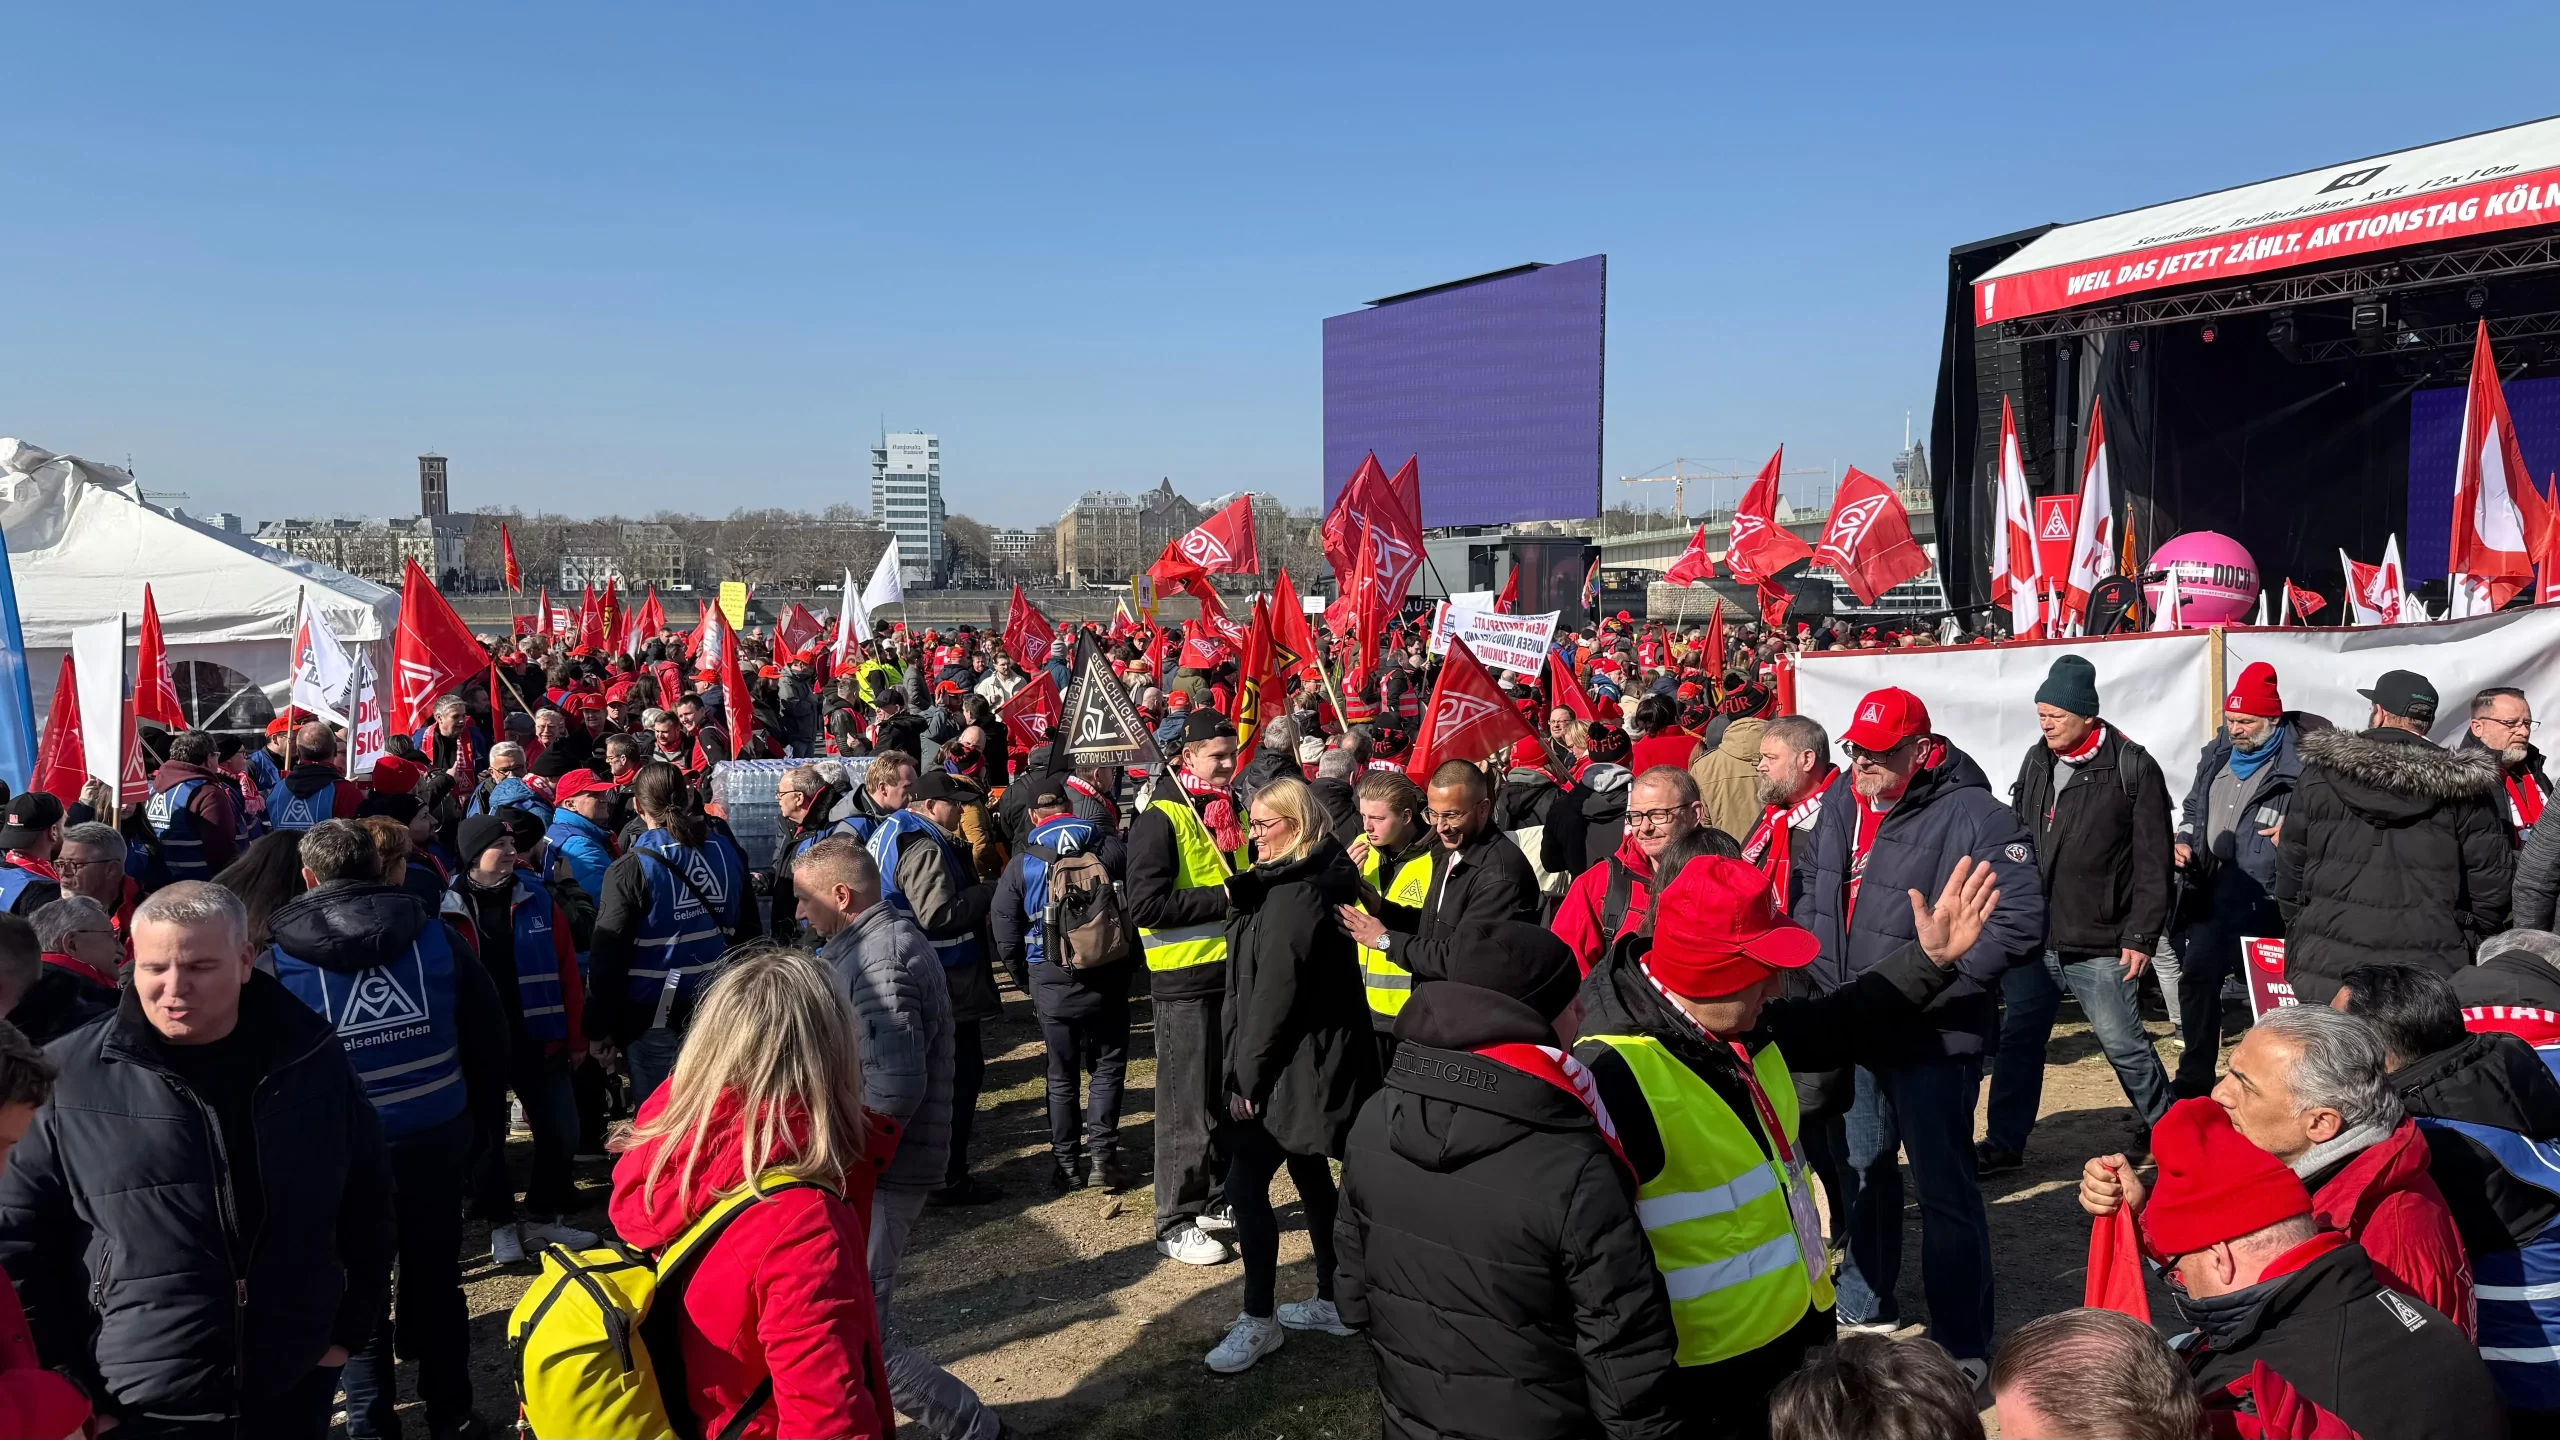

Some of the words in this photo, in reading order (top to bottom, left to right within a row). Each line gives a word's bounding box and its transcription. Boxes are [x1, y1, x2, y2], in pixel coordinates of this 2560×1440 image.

[2132, 225, 2221, 246] Soundline
[2227, 197, 2354, 228] Trailerbühne
[2360, 184, 2409, 201] XXL
[2417, 164, 2519, 189] 12x10m
[2066, 270, 2110, 296] WEIL
[2116, 259, 2158, 285] DAS
[2156, 246, 2225, 281] JETZT
[2224, 232, 2302, 264] ZÄHLT.
[2306, 198, 2480, 249] AKTIONSTAG
[2484, 183, 2560, 217] KÖLN
[2212, 563, 2250, 591] DOCH
[343, 1025, 431, 1051] elsenkirchen
